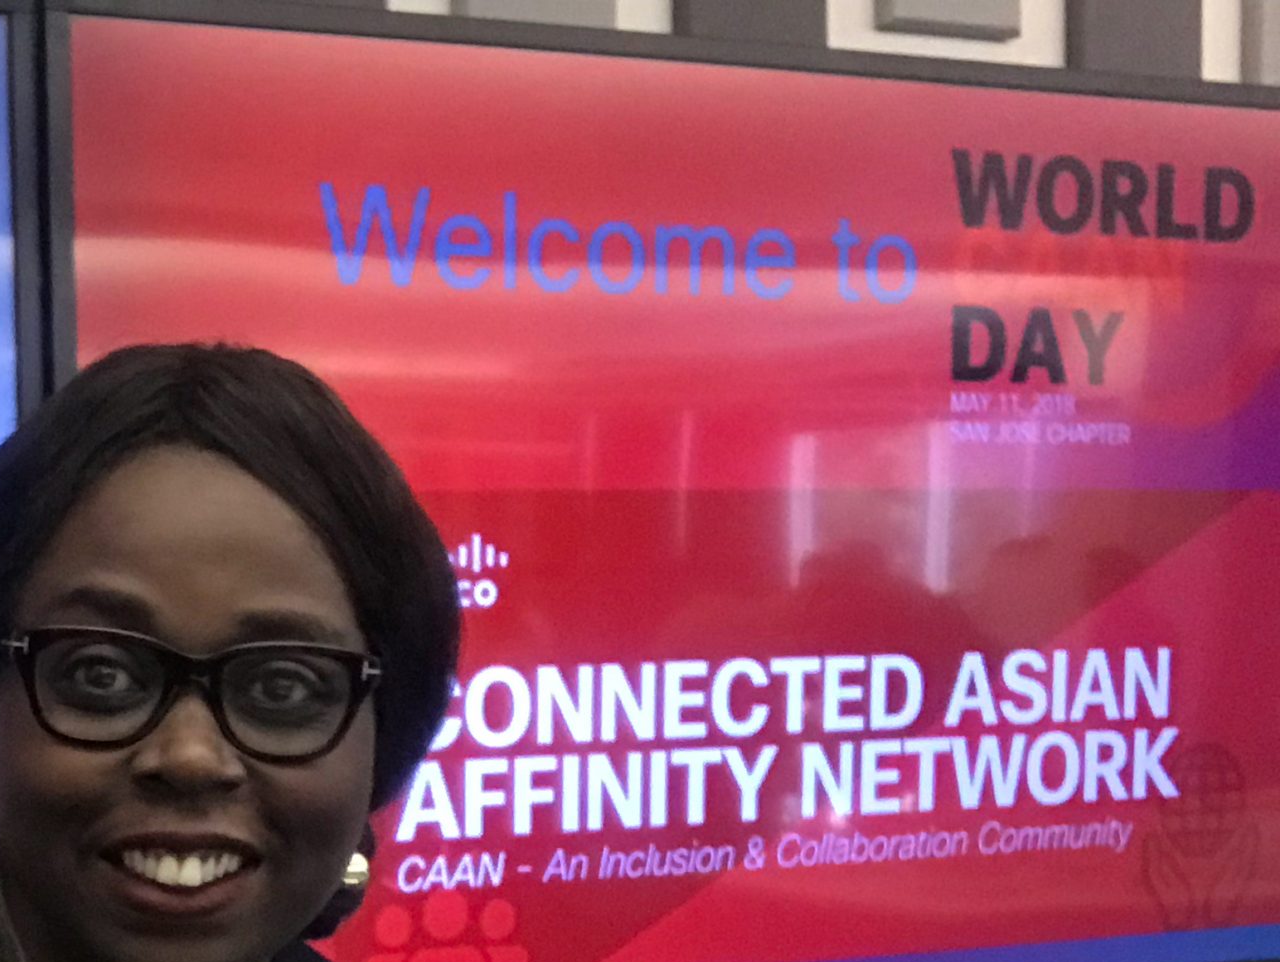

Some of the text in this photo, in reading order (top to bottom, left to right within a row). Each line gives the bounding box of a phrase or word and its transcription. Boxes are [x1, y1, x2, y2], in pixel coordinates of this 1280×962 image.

[951, 146, 1257, 244] WORLD
[319, 181, 797, 300] Welcome
[831, 217, 918, 304] to
[950, 303, 1126, 386] DAY
[949, 391, 993, 414] MAY
[949, 421, 992, 444] SAN
[1046, 422, 1133, 445] CHAPTER
[943, 645, 1172, 729] ASIAN
[394, 726, 1181, 843] AFFINITY NETWORK
[397, 851, 507, 894] CAAN
[542, 847, 589, 884] An
[598, 835, 737, 880] Inclusion
[742, 834, 767, 871] &
[776, 827, 970, 870] Collaboration
[977, 816, 1134, 855] Community
